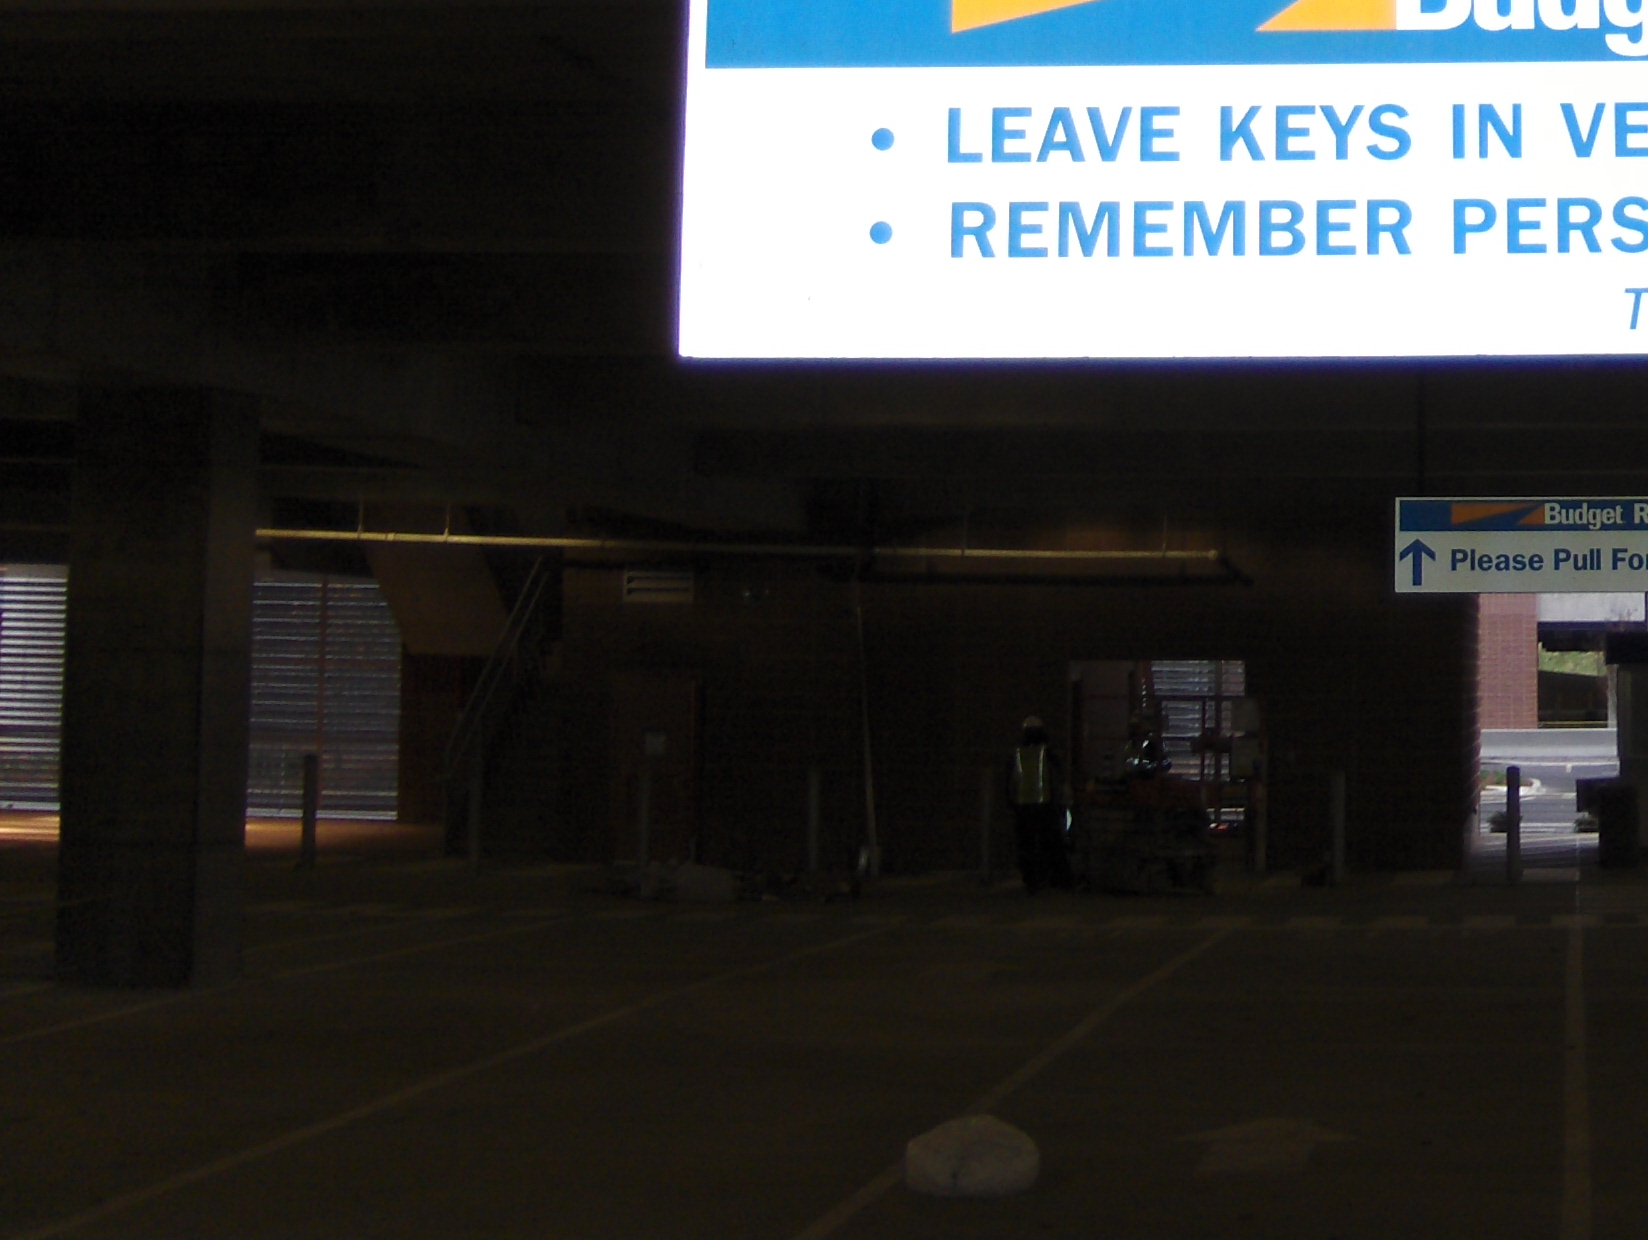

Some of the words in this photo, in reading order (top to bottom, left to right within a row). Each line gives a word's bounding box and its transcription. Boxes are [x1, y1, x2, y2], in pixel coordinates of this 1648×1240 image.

[948, 107, 1179, 163] LEAVE
[1220, 104, 1411, 161] KEYS
[1453, 104, 1521, 159] IN
[951, 200, 1411, 257] REMEMBER
[1545, 503, 1622, 529] Budget
[1451, 549, 1543, 571] Please
[1554, 549, 1601, 570] Pull
